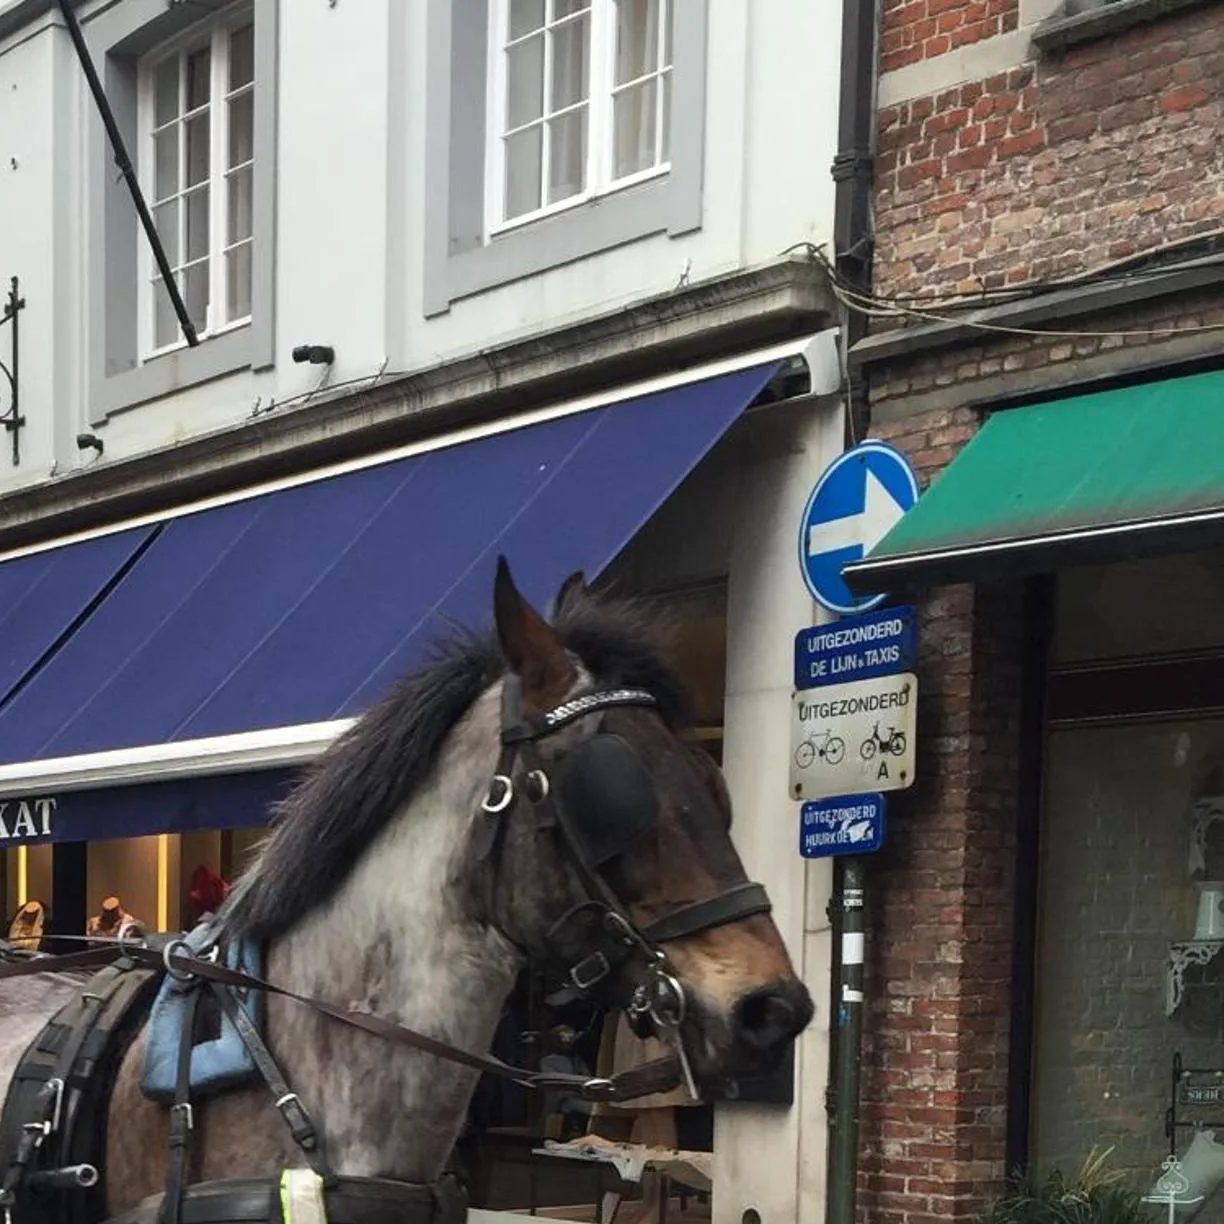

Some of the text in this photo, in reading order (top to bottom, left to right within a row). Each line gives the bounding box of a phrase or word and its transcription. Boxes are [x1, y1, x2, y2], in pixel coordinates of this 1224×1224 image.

[808, 619, 902, 653] UITGEZONDERD
[810, 660, 827, 678] DE
[831, 654, 856, 674] LIJN
[865, 645, 900, 667] TAXIS
[799, 691, 909, 722] UITGEZONDERD
[877, 761, 889, 780] A
[804, 804, 877, 826] UITGEZONDERD
